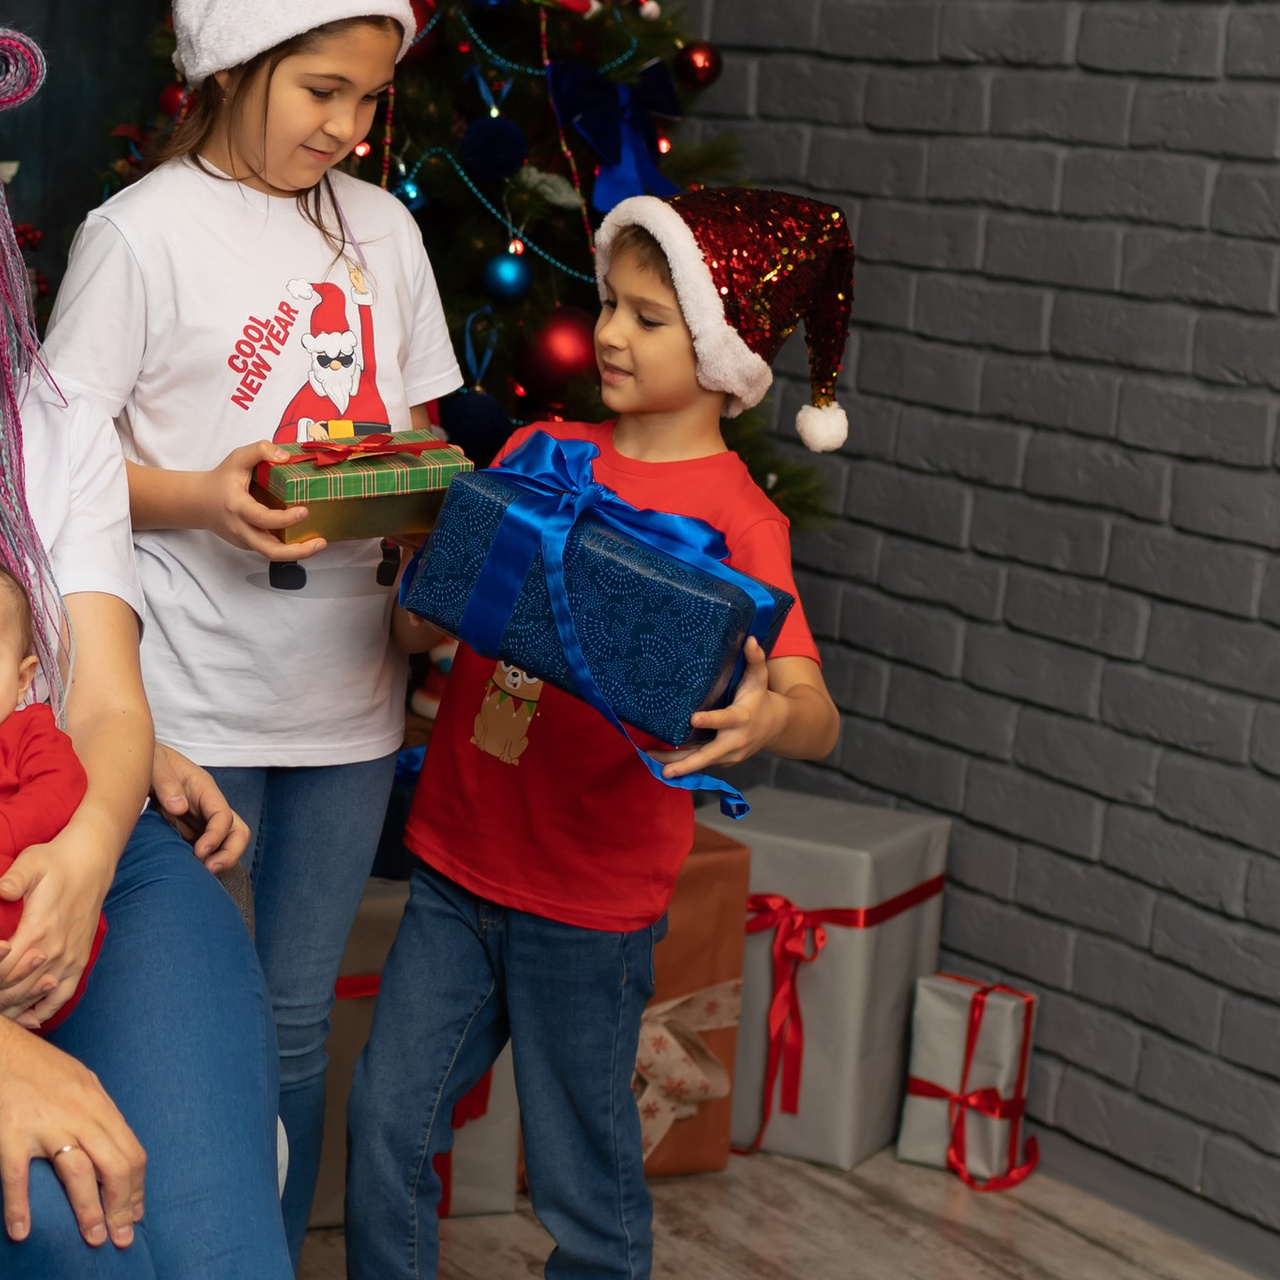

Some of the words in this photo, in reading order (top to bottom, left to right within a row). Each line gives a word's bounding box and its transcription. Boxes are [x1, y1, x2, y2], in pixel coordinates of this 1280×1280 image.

[228, 316, 271, 373] COOL
[231, 353, 272, 410] NEW
[260, 301, 299, 356] YEAR
